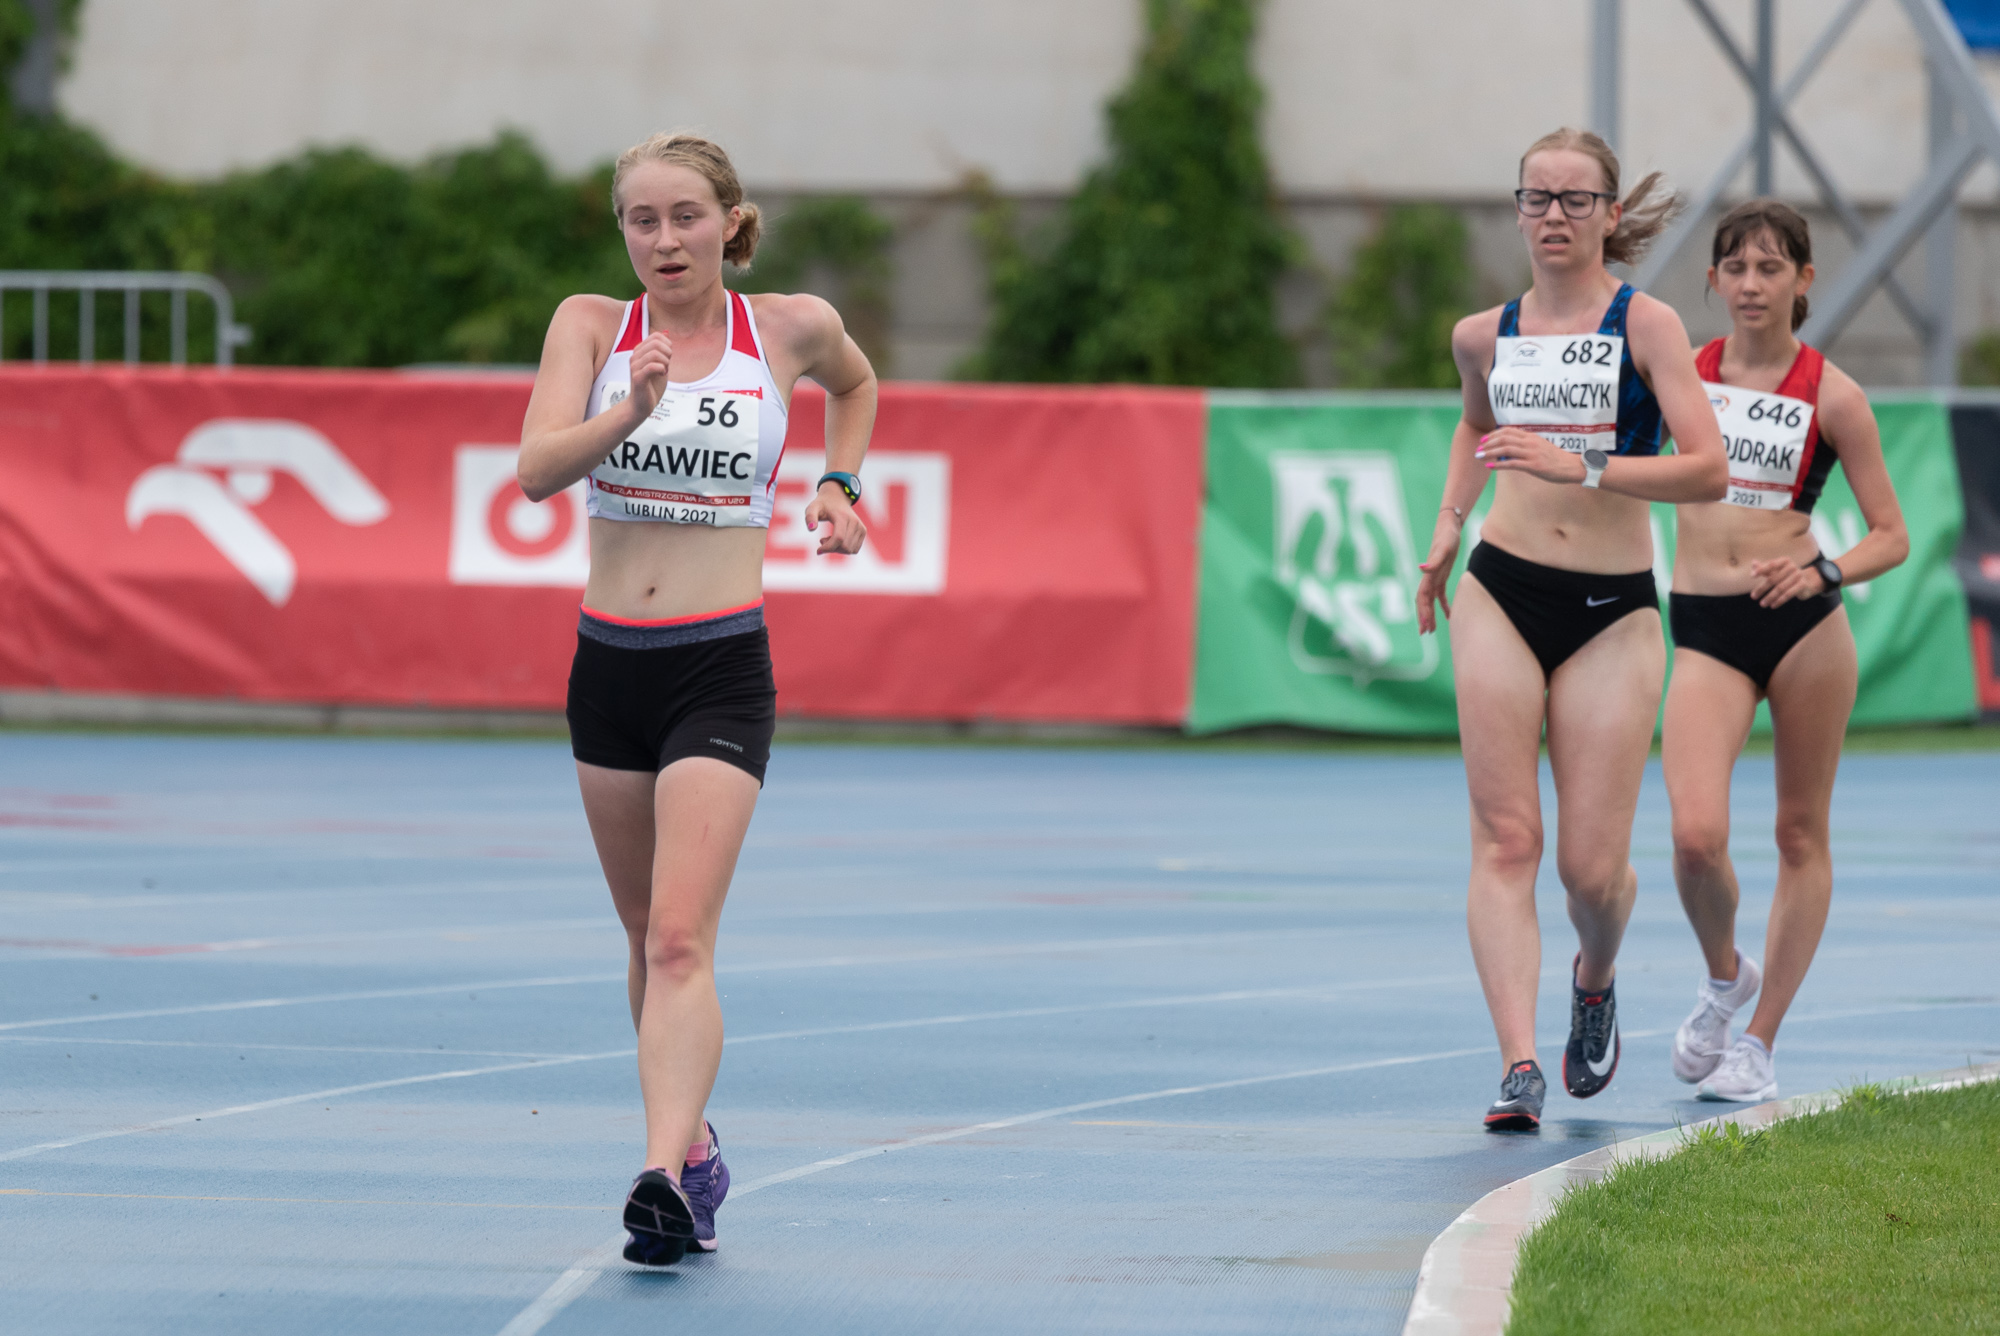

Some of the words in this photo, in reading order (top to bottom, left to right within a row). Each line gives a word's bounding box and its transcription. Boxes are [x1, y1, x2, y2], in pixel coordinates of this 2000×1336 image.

[1561, 340, 1613, 366] 682
[1493, 378, 1611, 409] WALERIAŃCZYK
[697, 397, 739, 428] 56
[1748, 399, 1801, 428] 646
[1560, 437, 1587, 450] 2021
[634, 490, 697, 503] MISTRZOSTWA
[698, 496, 726, 505] POLSKI
[727, 497, 745, 505] U20
[1732, 490, 1763, 506] 2021
[624, 502, 675, 520] LUBLIN
[680, 509, 717, 524] 2021
